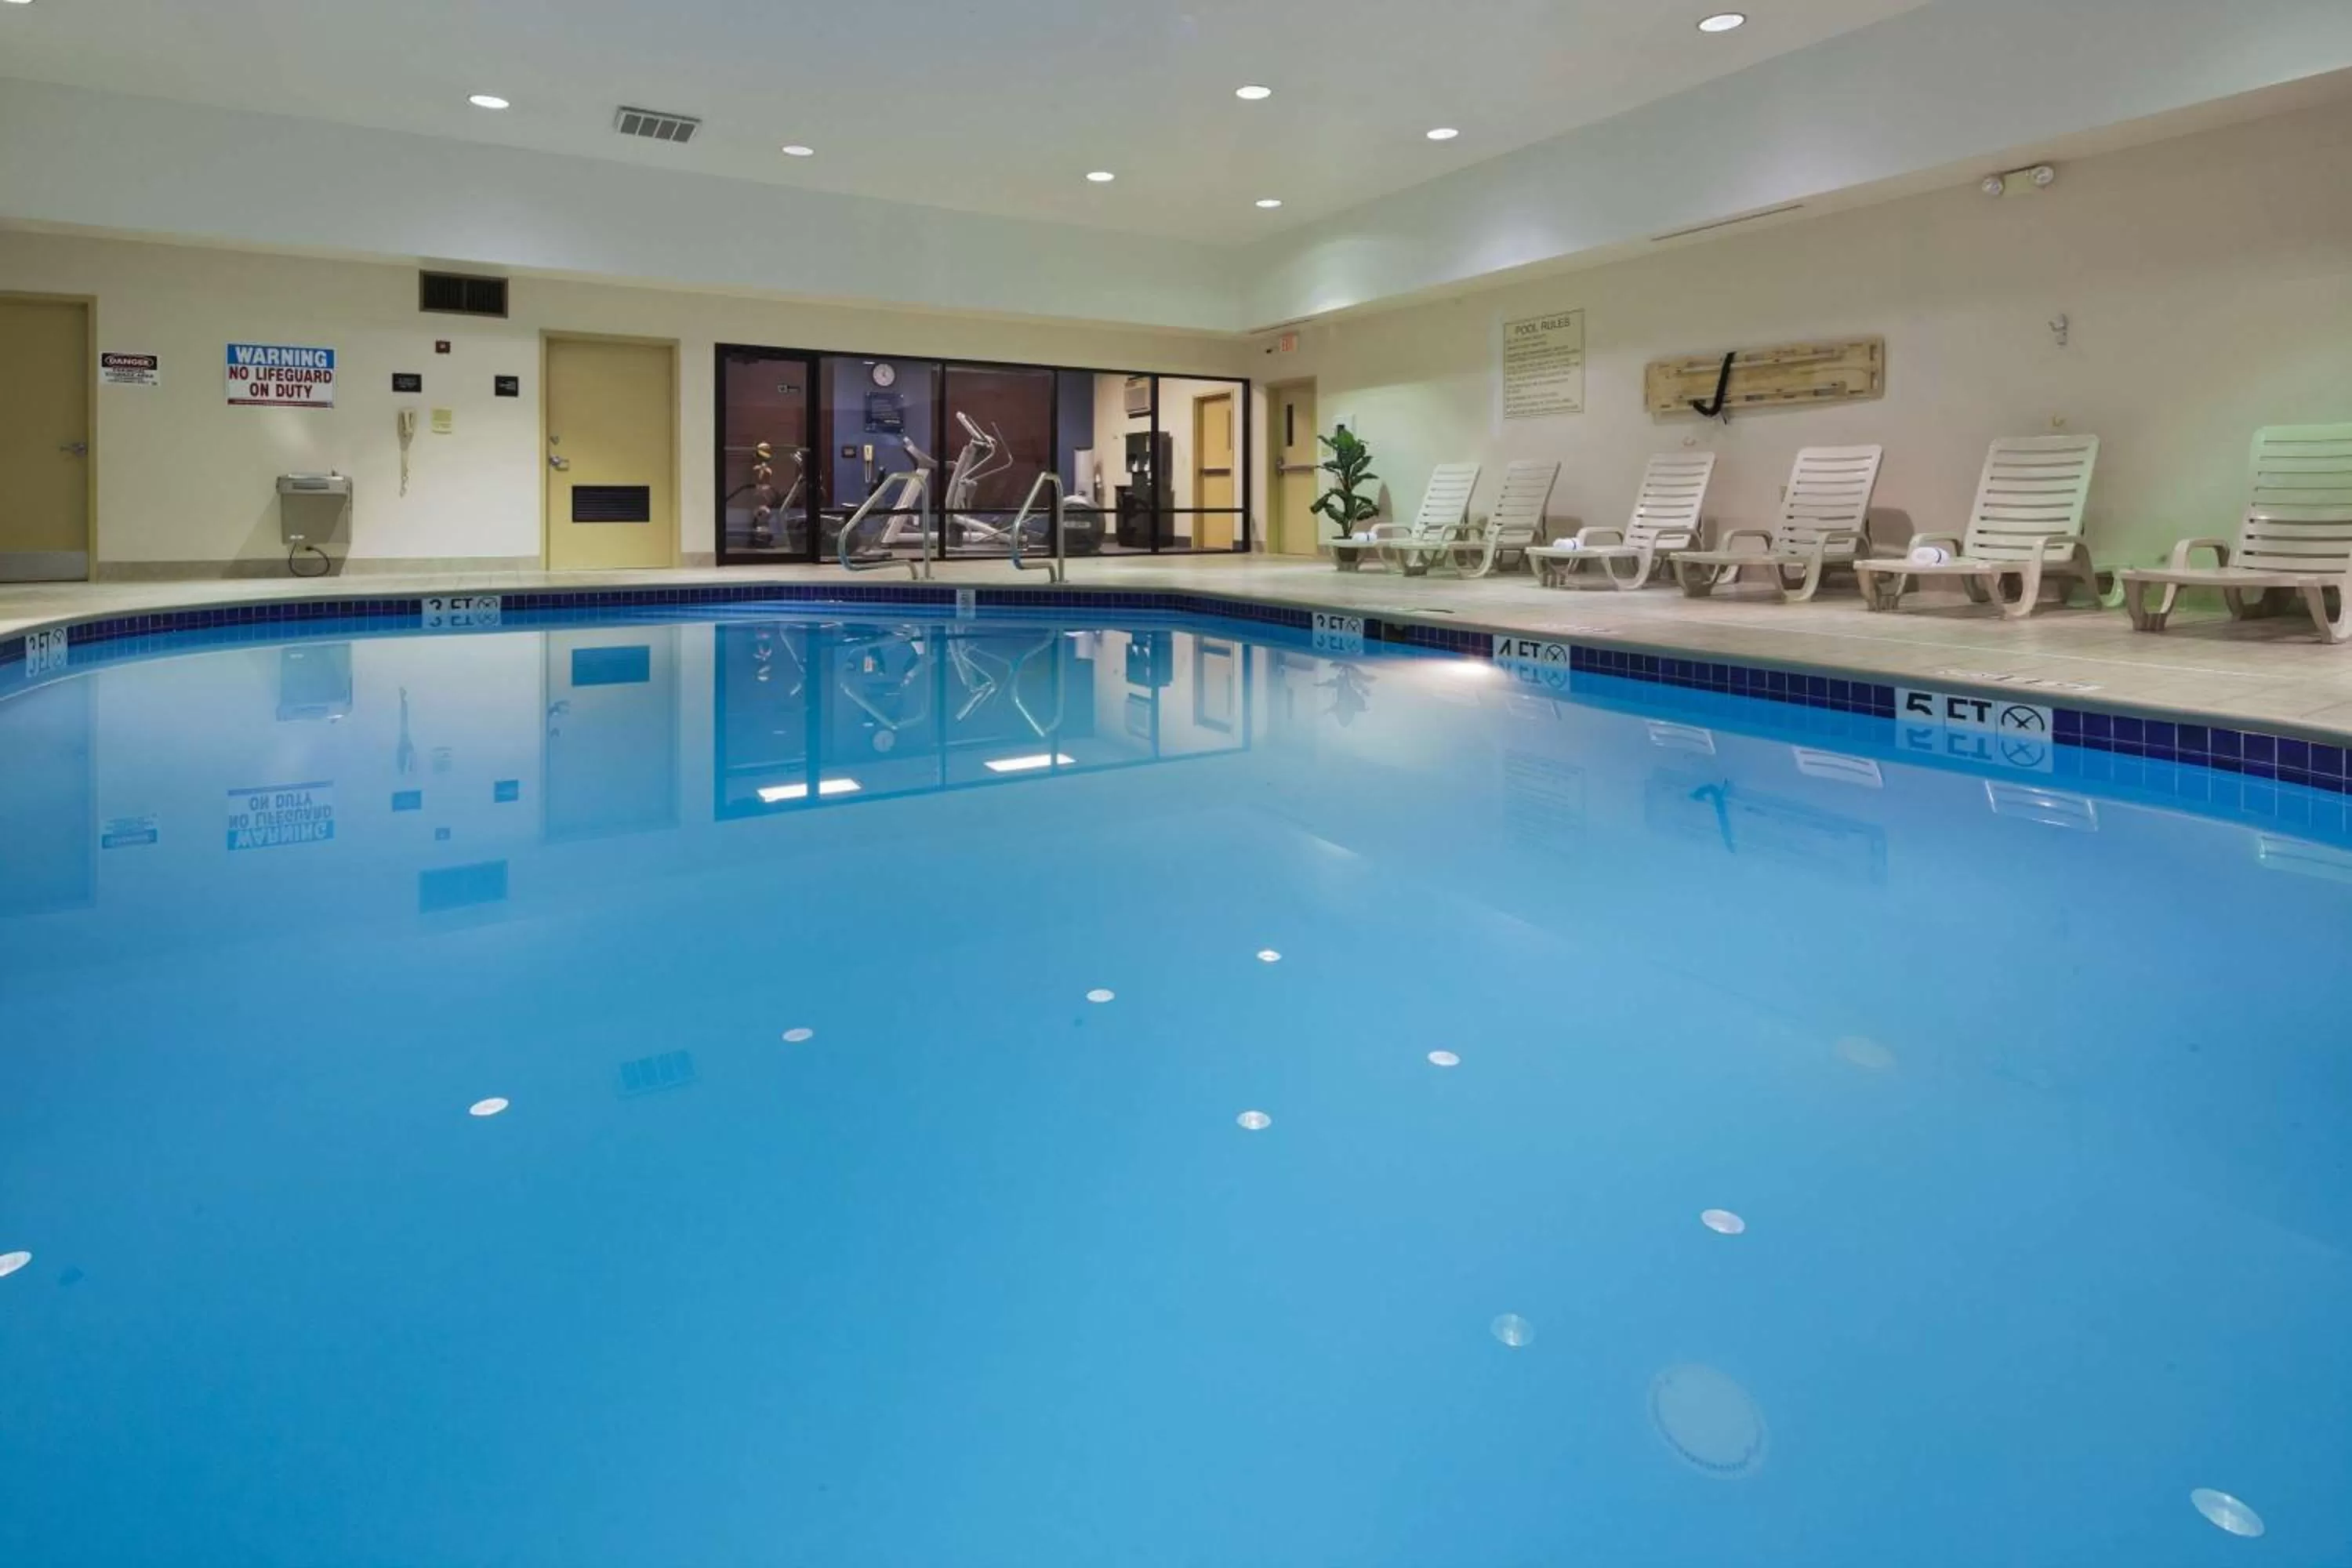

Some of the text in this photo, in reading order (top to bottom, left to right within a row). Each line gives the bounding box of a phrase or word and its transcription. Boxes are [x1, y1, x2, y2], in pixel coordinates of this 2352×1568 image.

[236, 346, 328, 368] WARNING
[228, 366, 332, 383] NO LIFEGUARD
[249, 383, 313, 398] ON DUTY
